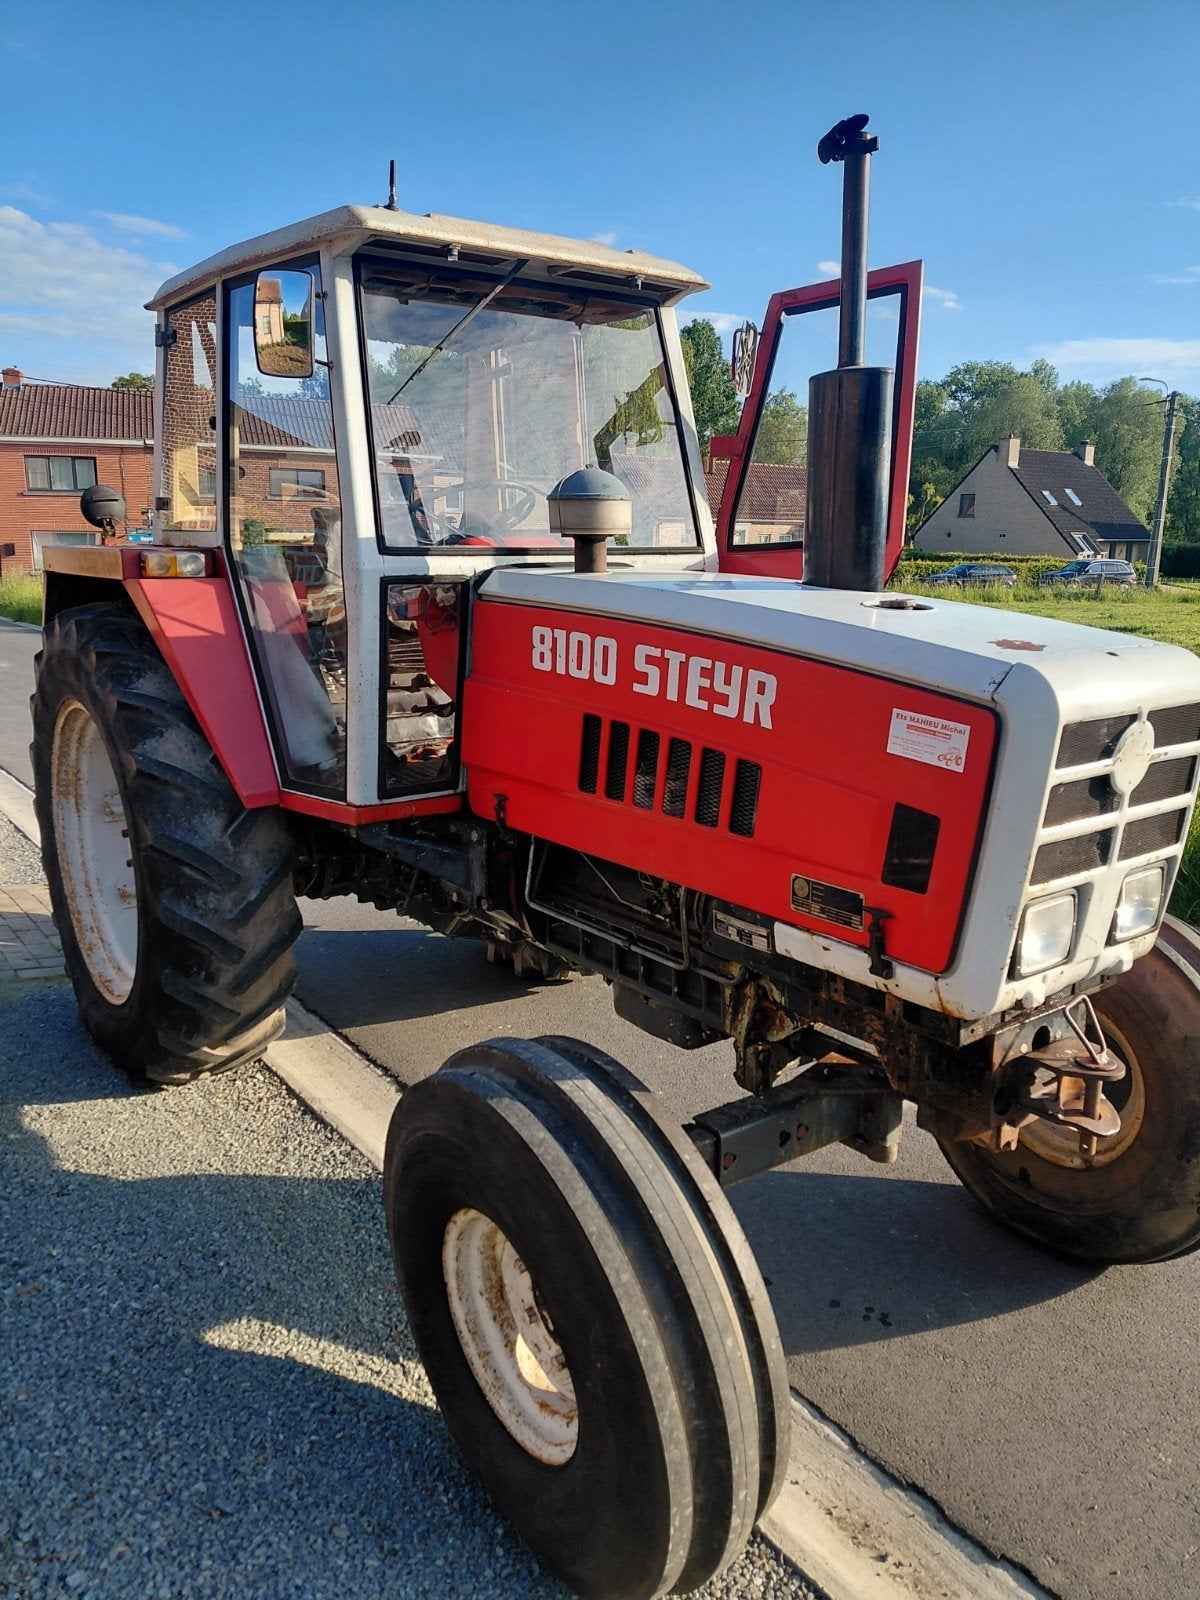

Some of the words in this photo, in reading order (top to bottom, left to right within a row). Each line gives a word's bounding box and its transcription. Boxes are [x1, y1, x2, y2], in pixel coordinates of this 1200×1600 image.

[532, 625, 617, 686] 8100
[632, 644, 778, 730] STEYR
[896, 712, 908, 720] Ets
[909, 716, 939, 728] MAHIEU
[941, 724, 966, 735] Michel
